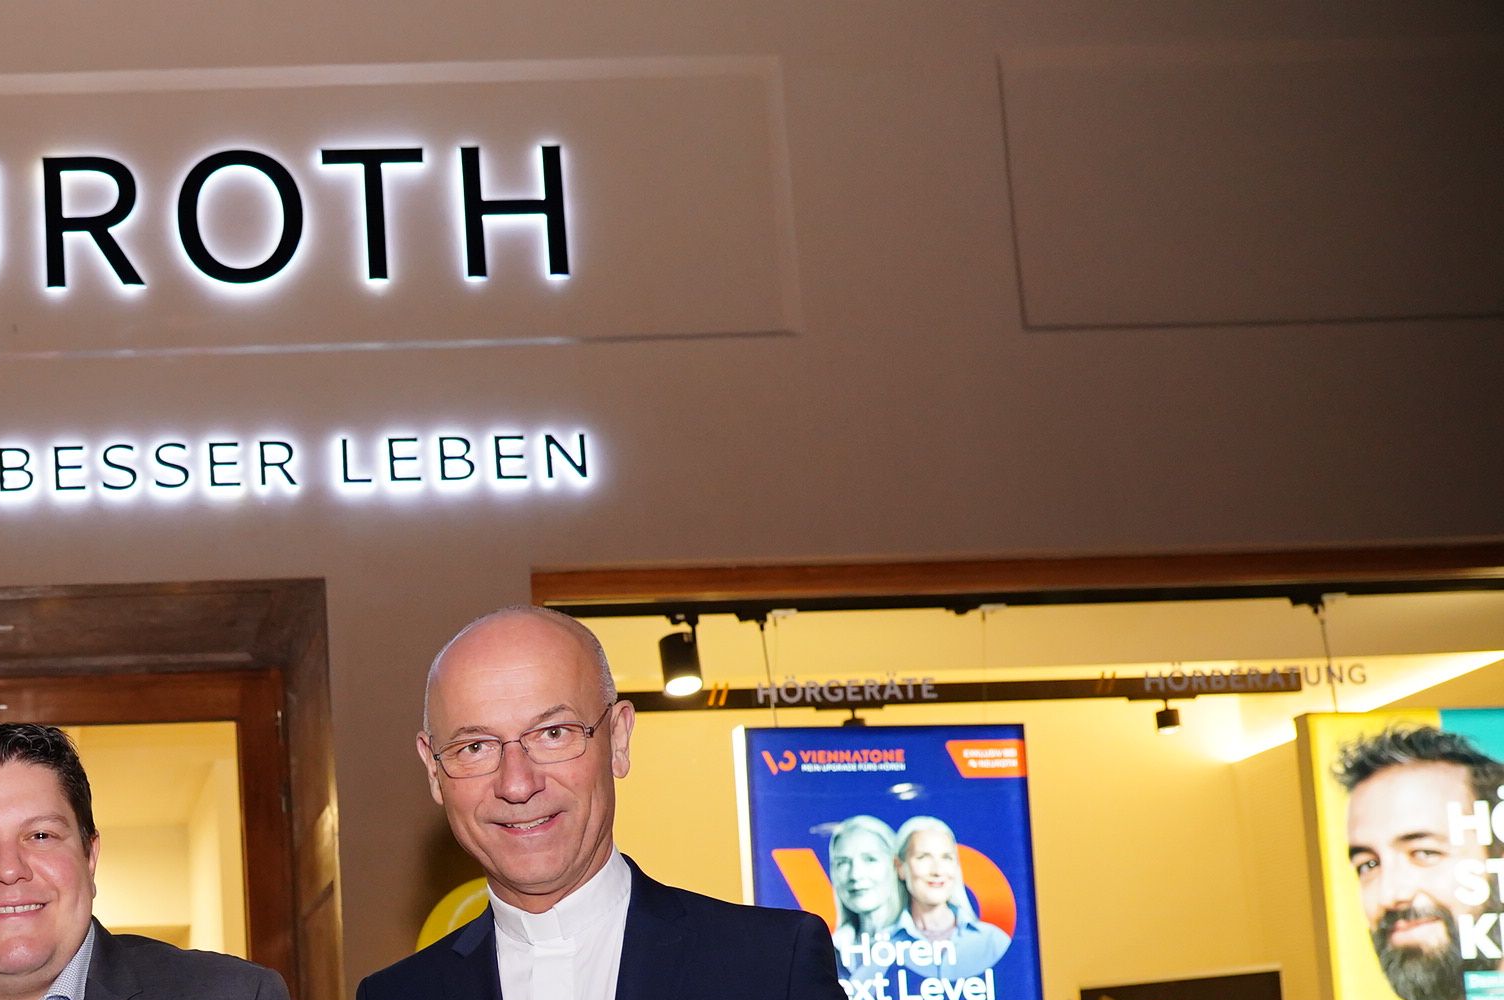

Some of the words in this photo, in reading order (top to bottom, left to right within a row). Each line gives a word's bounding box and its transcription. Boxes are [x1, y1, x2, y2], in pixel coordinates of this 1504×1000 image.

[341, 433, 589, 485] LEBEN
[756, 672, 939, 704] HÖRGERÄTE
[1144, 661, 1367, 692] HÖRBERATUNG
[799, 749, 905, 763] VIENNATONE
[843, 931, 957, 968] Hören
